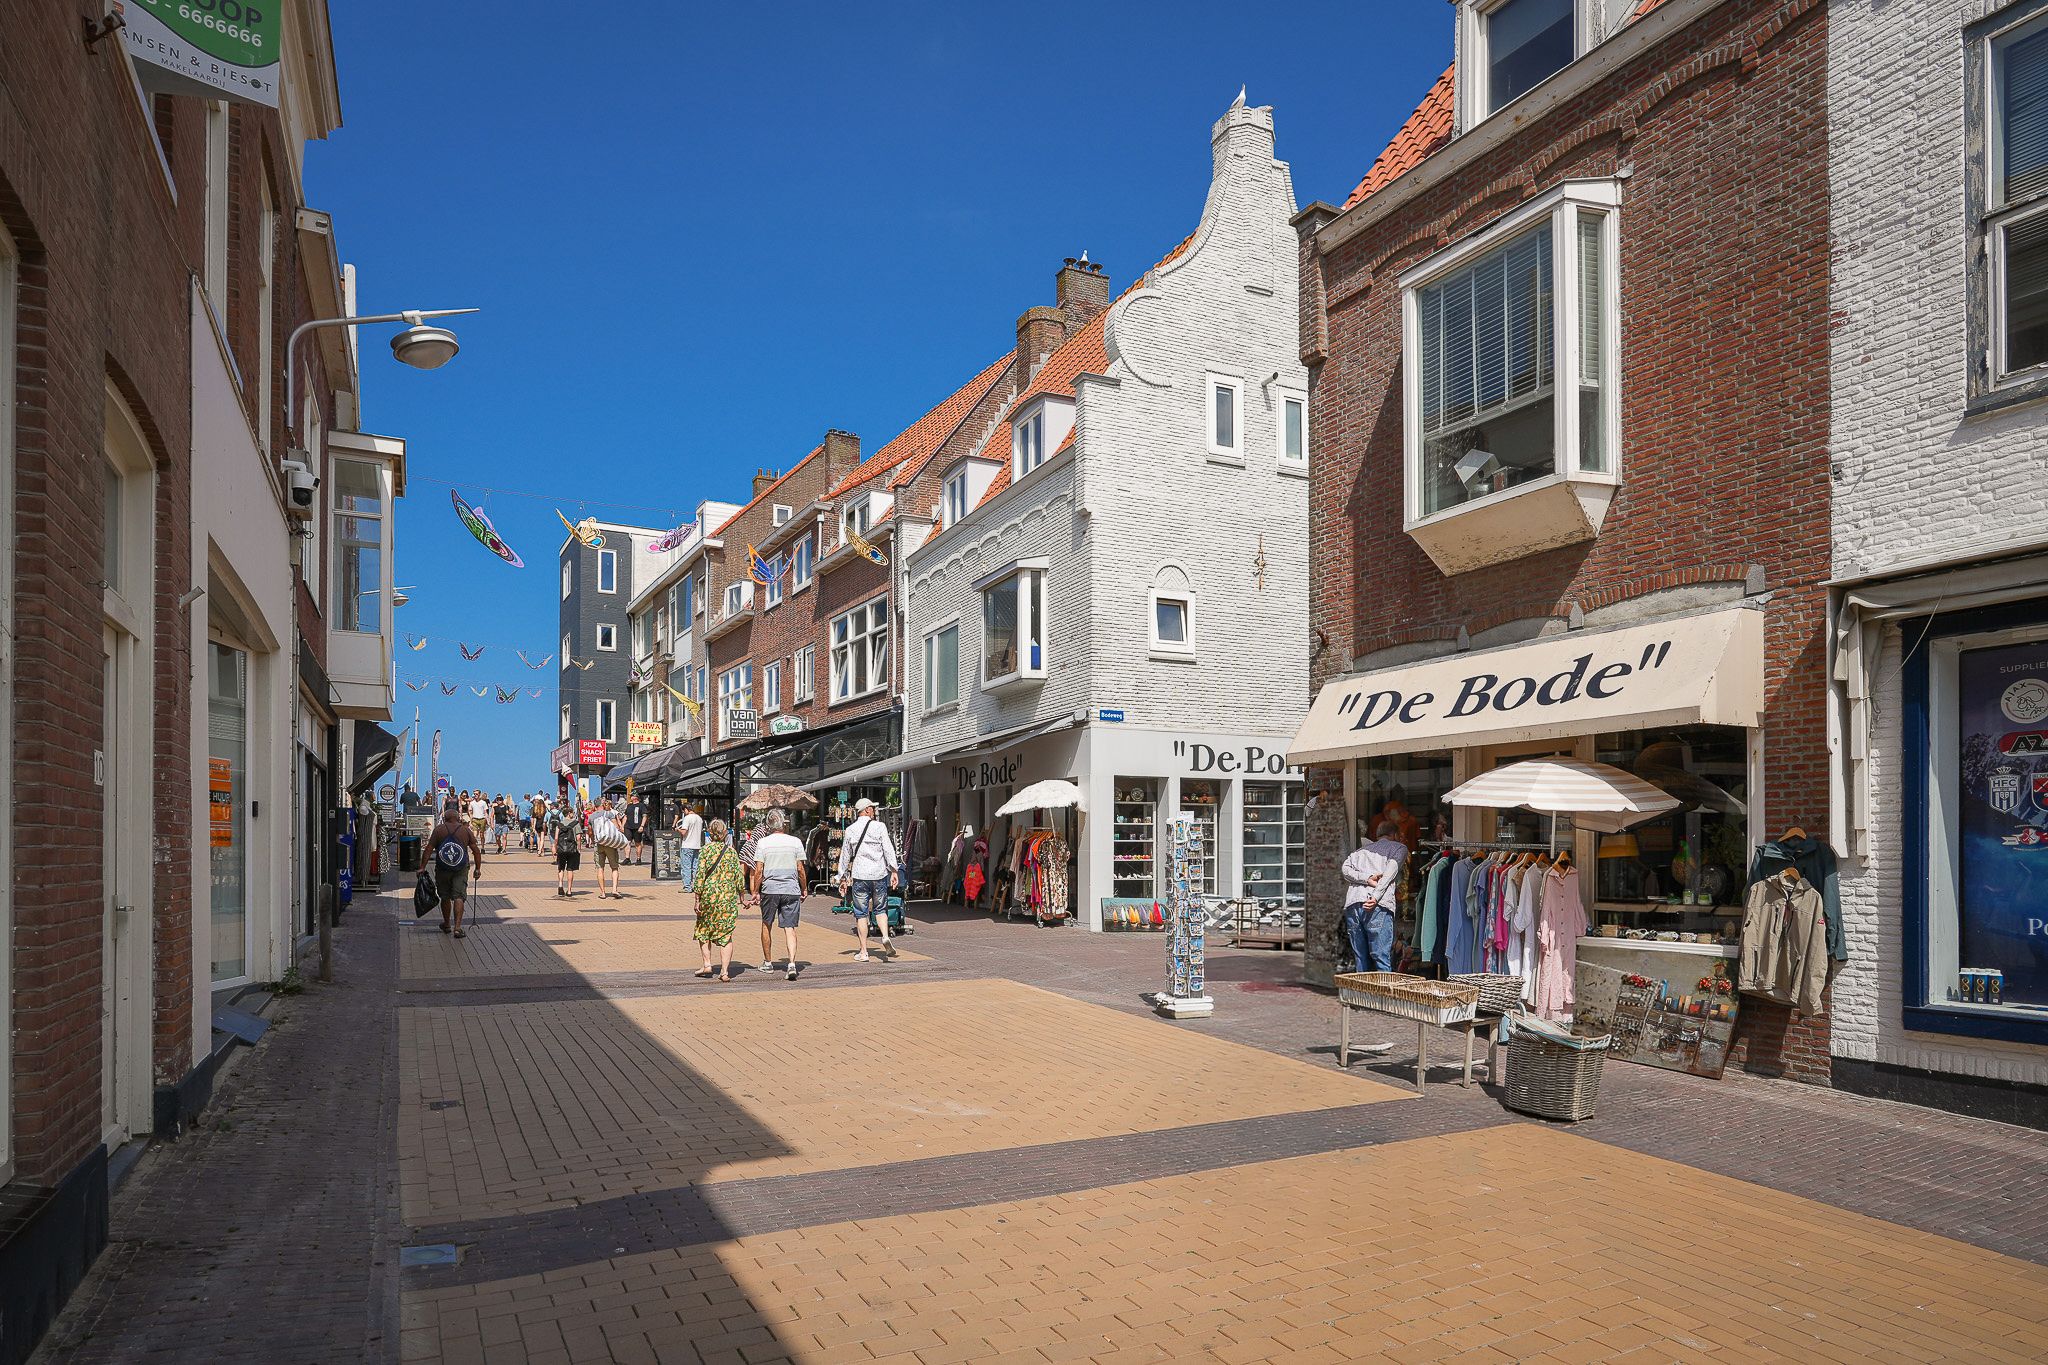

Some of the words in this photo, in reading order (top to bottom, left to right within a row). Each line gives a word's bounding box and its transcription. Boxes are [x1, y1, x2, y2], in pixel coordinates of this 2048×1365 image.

[178, 4, 263, 48] 6666666
[190, 55, 201, 68] &
[160, 57, 226, 88] MAKELAARDIJ
[1999, 660, 2048, 674] SUPPLIE
[2005, 681, 2027, 703] AJAX
[732, 710, 754, 719] van
[775, 721, 800, 733] Grolsch
[1993, 779, 2017, 787] HFC
